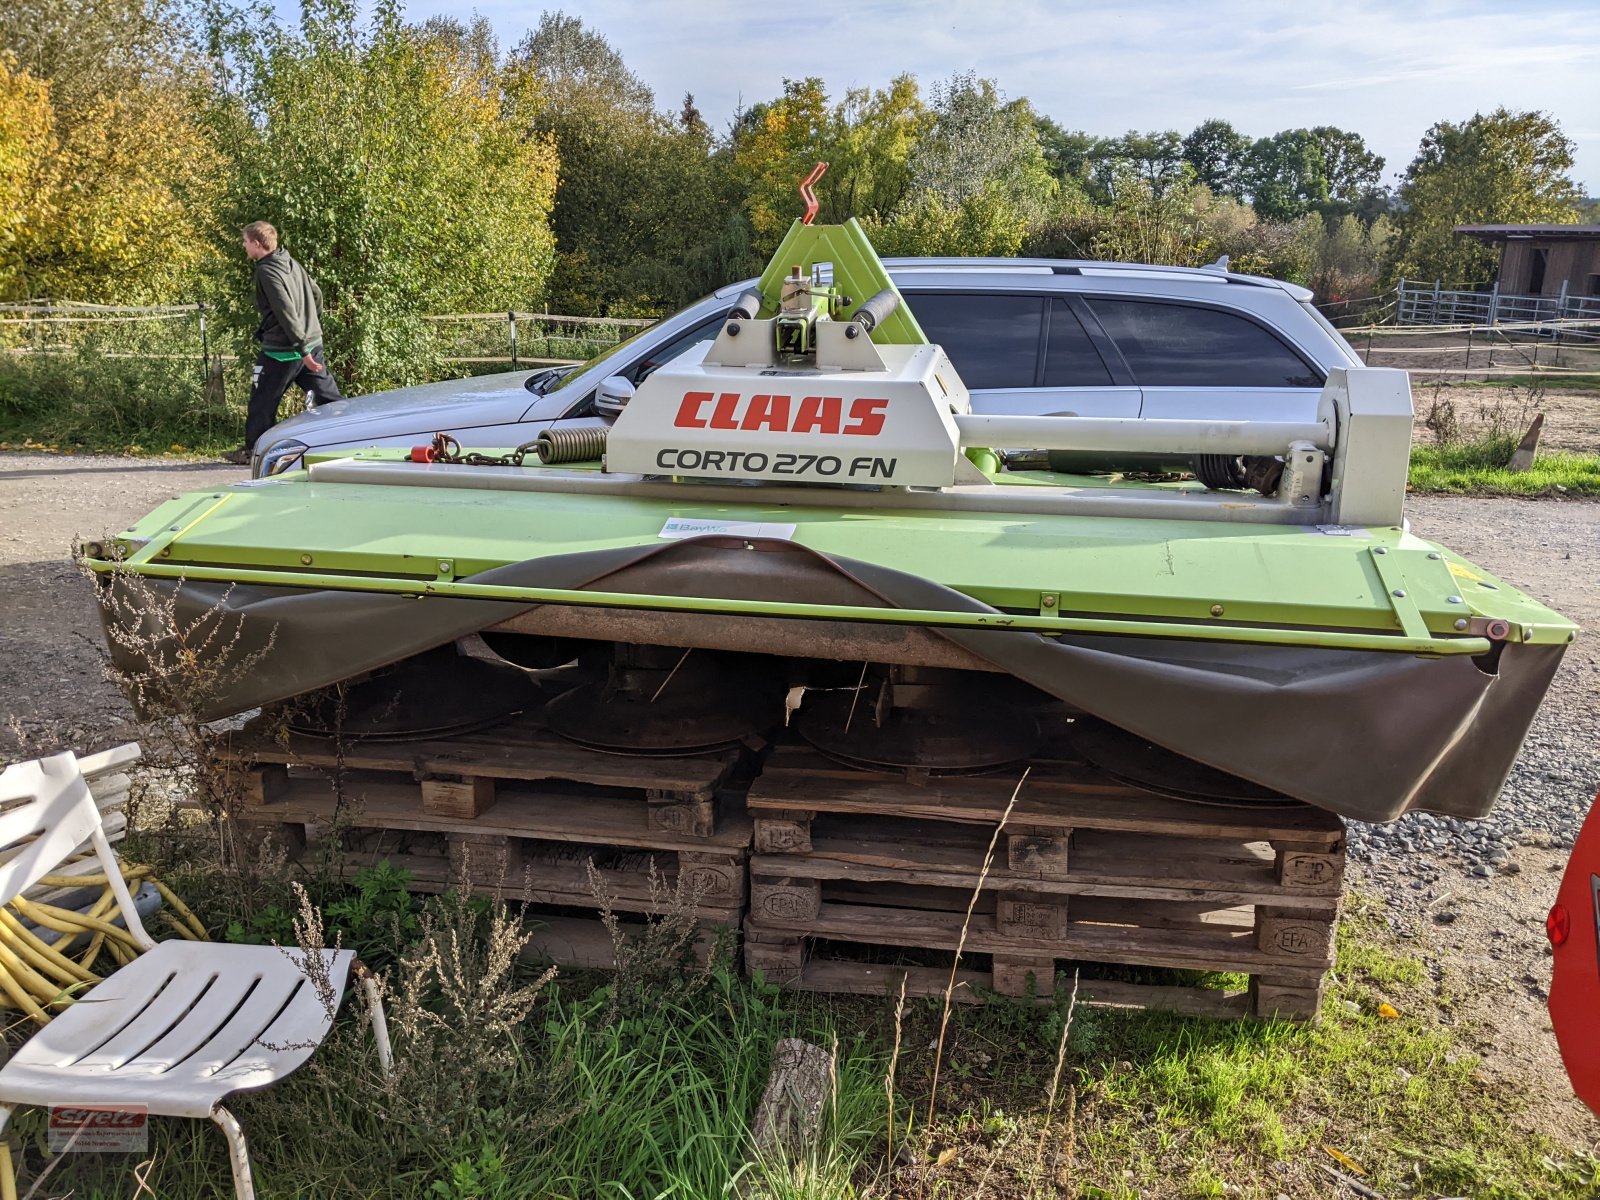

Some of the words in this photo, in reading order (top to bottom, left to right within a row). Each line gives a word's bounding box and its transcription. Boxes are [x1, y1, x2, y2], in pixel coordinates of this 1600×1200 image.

[674, 391, 889, 436] CLAAS
[656, 448, 769, 473] CORTO
[772, 453, 842, 476] 270
[848, 457, 897, 478] FN
